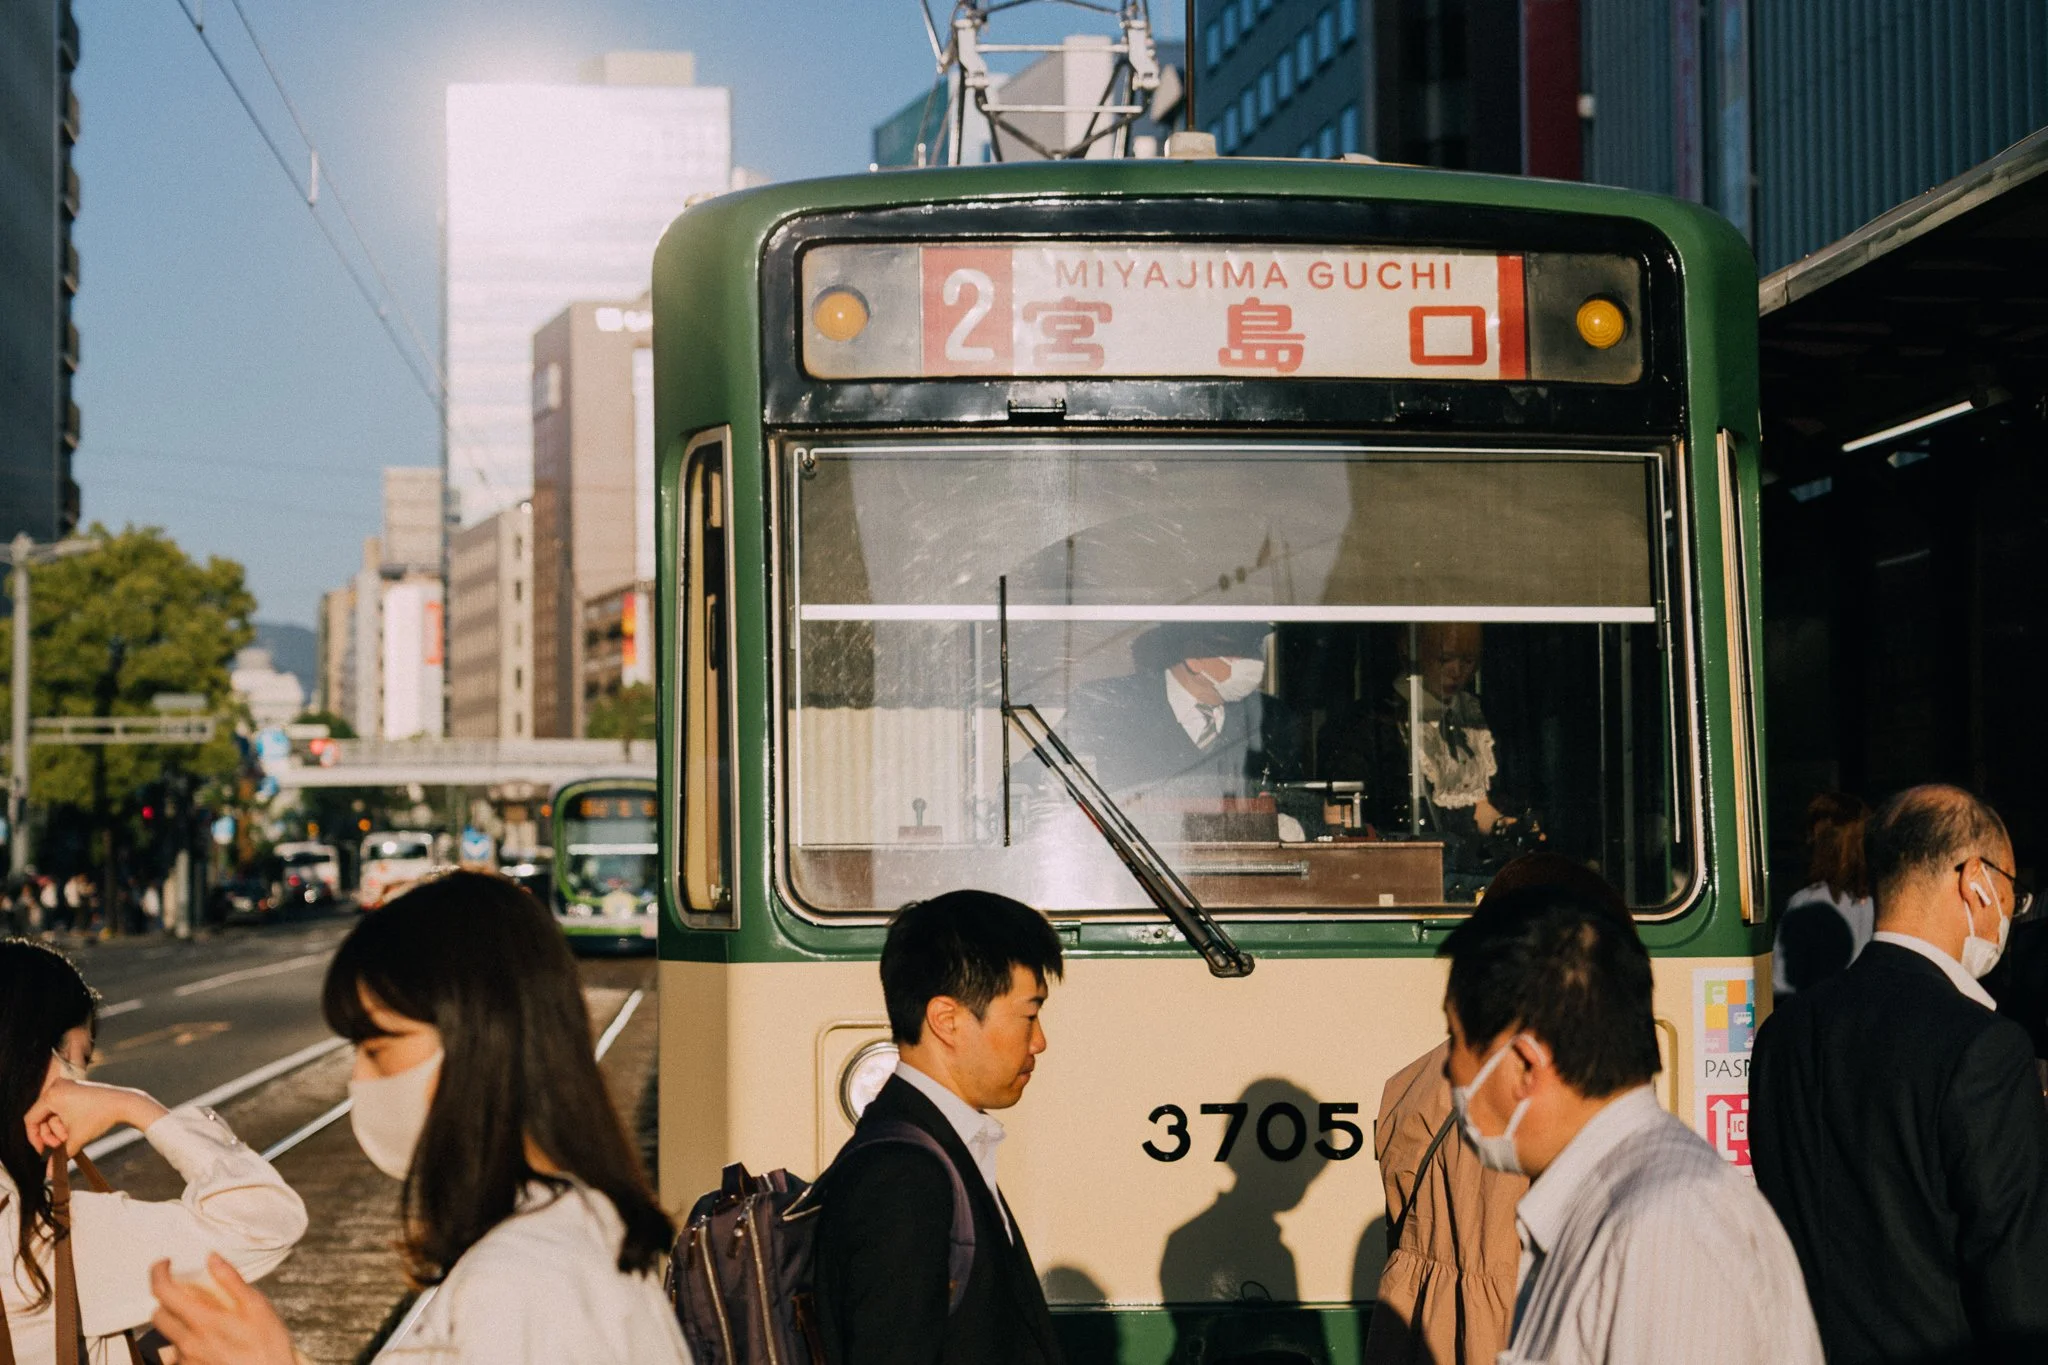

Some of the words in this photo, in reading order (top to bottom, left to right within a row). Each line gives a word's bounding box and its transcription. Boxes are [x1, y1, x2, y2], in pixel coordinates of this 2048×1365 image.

[1055, 260, 1288, 288] MIYAJIMA
[1307, 261, 1451, 290] GUCHI
[942, 267, 995, 361] 2
[1022, 295, 1487, 373] 宮島口
[1142, 1102, 1379, 1162] 3705
[1733, 1120, 1745, 1133] IC
